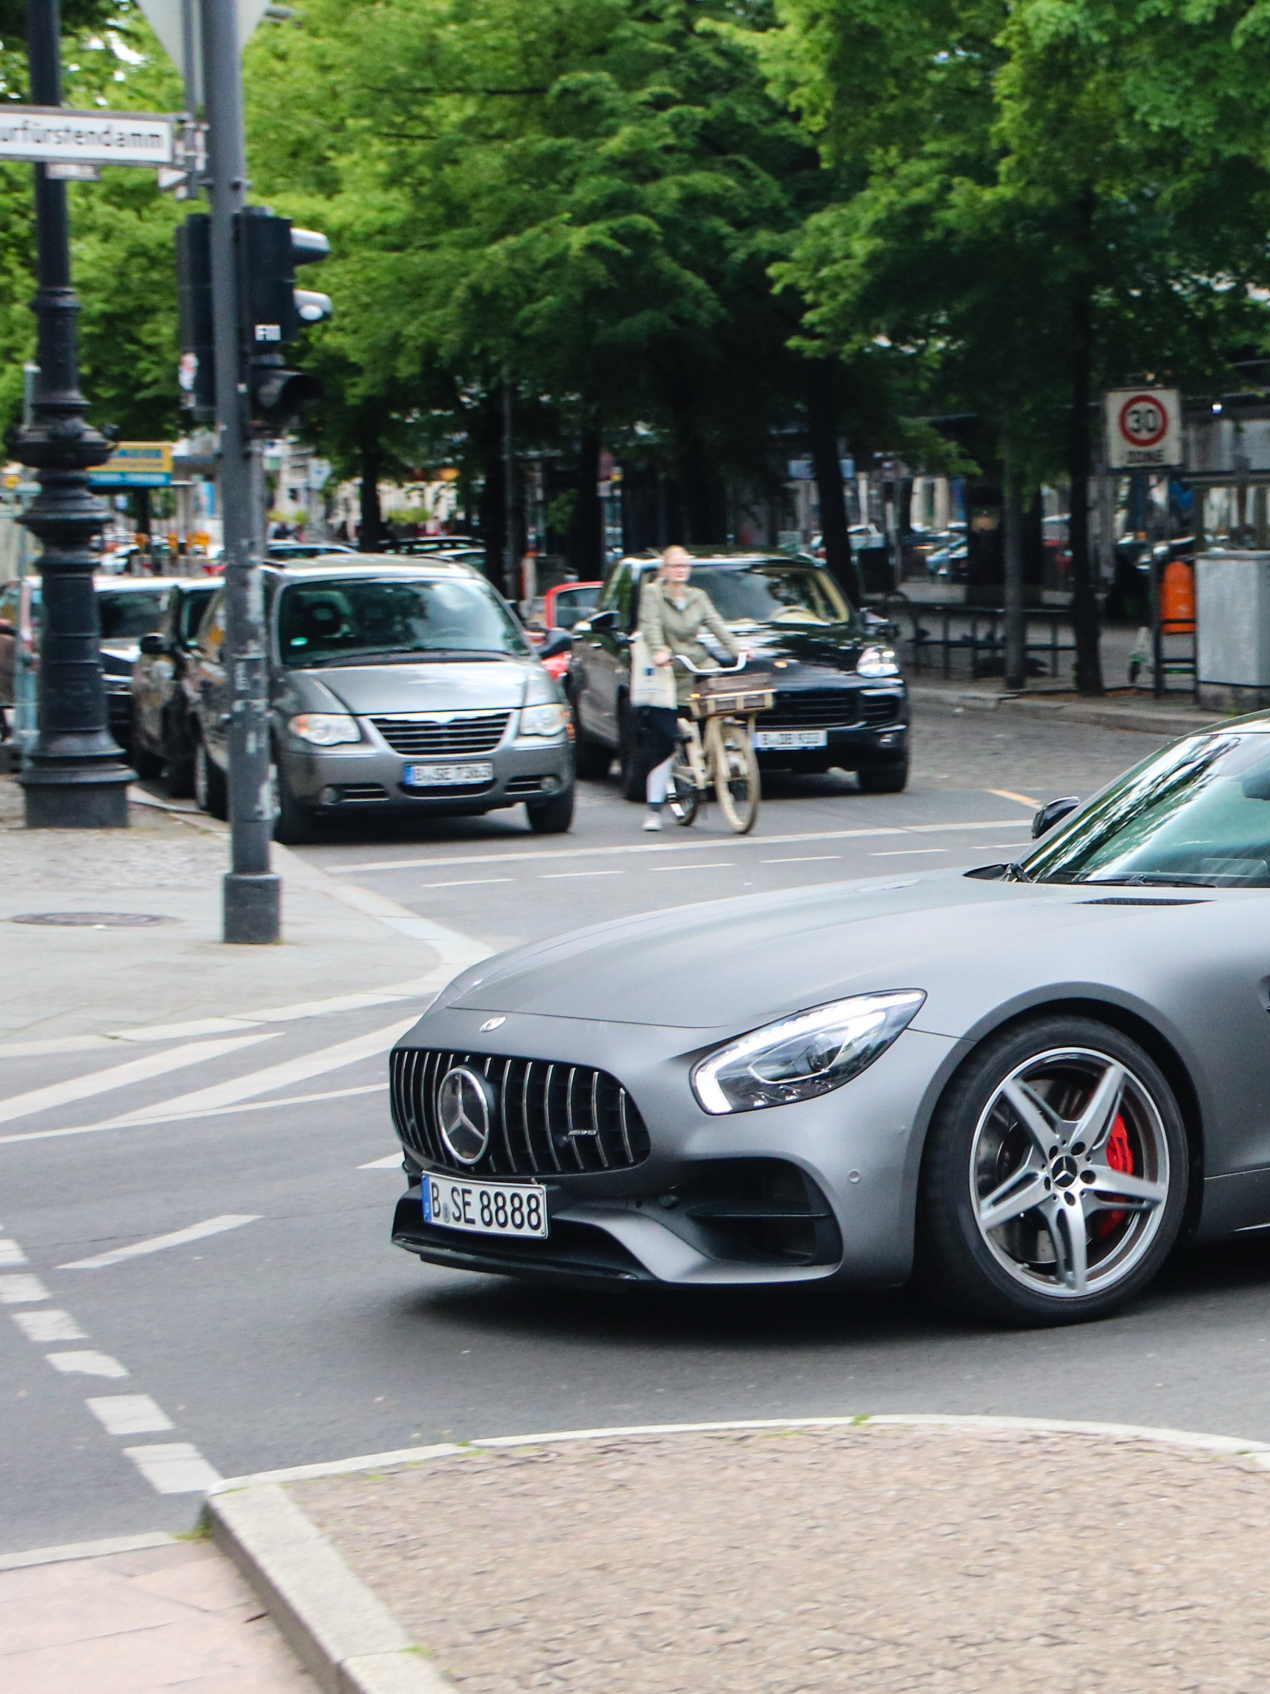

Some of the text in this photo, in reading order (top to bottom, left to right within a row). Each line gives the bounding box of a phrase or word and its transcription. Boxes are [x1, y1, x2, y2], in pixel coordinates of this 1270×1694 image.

[1127, 409, 1159, 433] 30
[431, 1181, 542, 1231] B SE 8888
